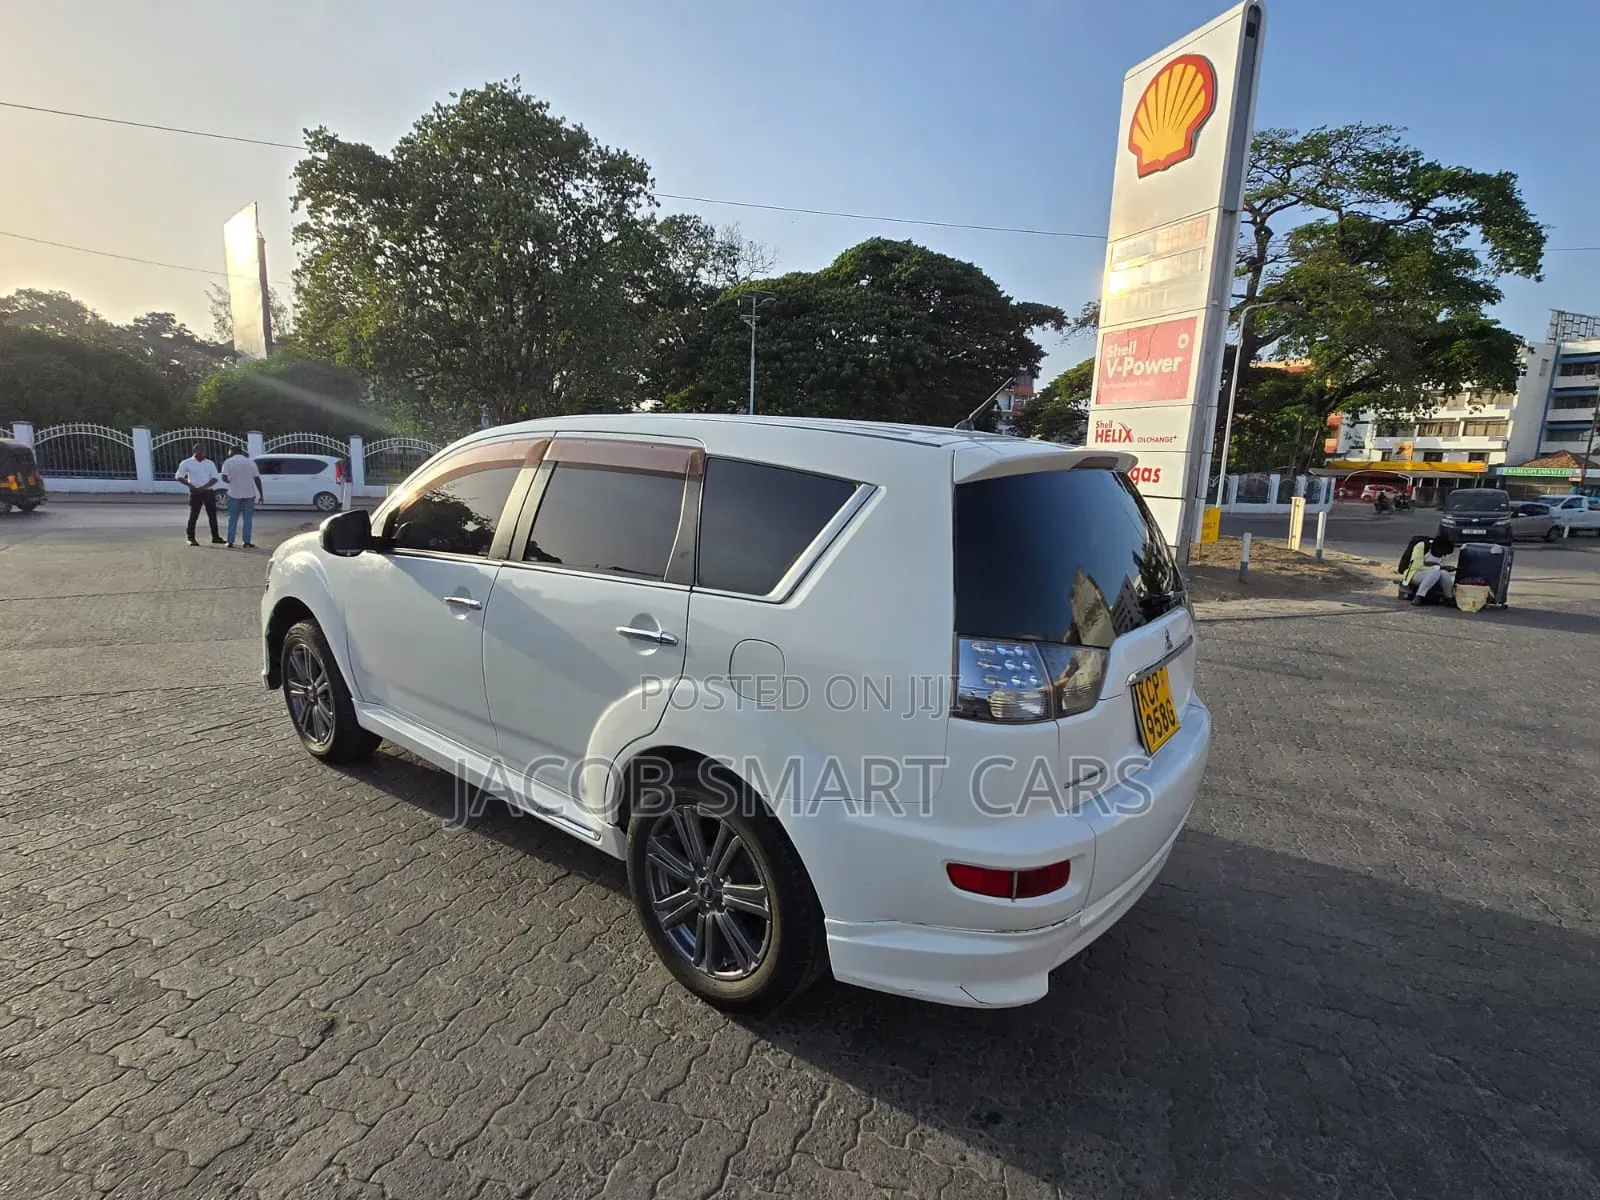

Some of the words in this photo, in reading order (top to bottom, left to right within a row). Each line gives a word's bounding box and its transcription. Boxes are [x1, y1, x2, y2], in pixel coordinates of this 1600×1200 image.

[1106, 340, 1137, 358] Shell
[1106, 356, 1183, 379] V-Power
[1095, 420, 1113, 429] Shell
[1095, 426, 1133, 443] HELIX
[1146, 699, 1176, 744] 958G
